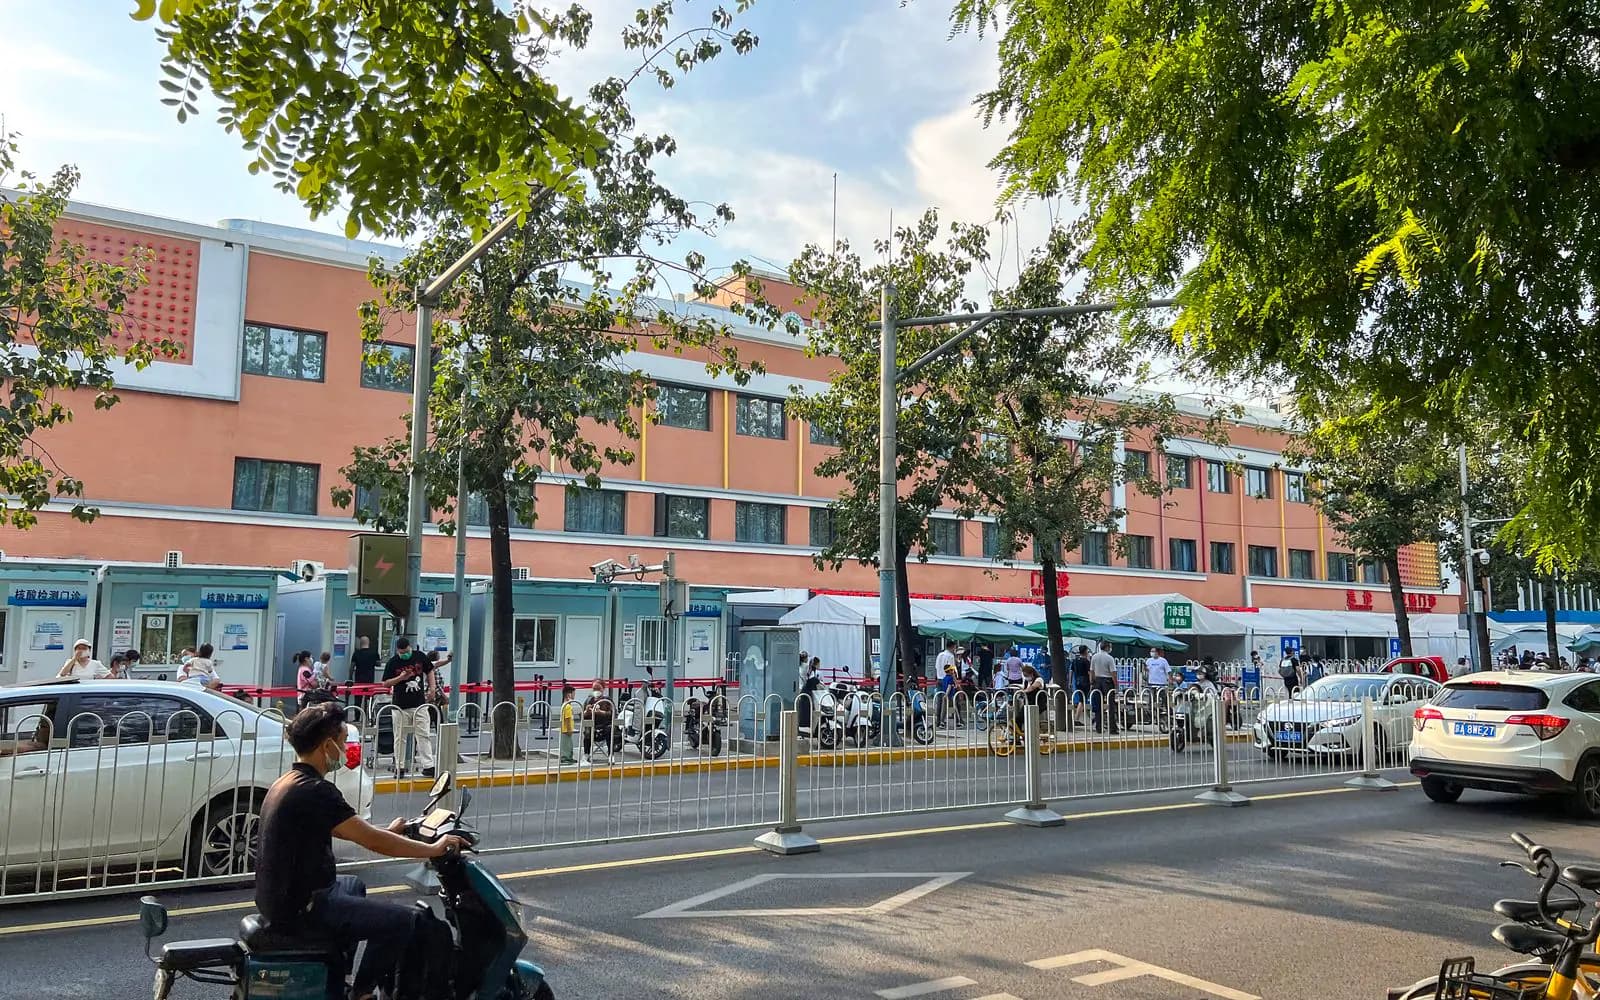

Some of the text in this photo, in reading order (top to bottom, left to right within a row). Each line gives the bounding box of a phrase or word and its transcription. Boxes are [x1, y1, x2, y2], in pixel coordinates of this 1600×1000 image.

[15, 589, 81, 601] 核酸检测门诊
[206, 592, 263, 603] 核酸检测门诊
[1166, 606, 1191, 617] 门诊通道
